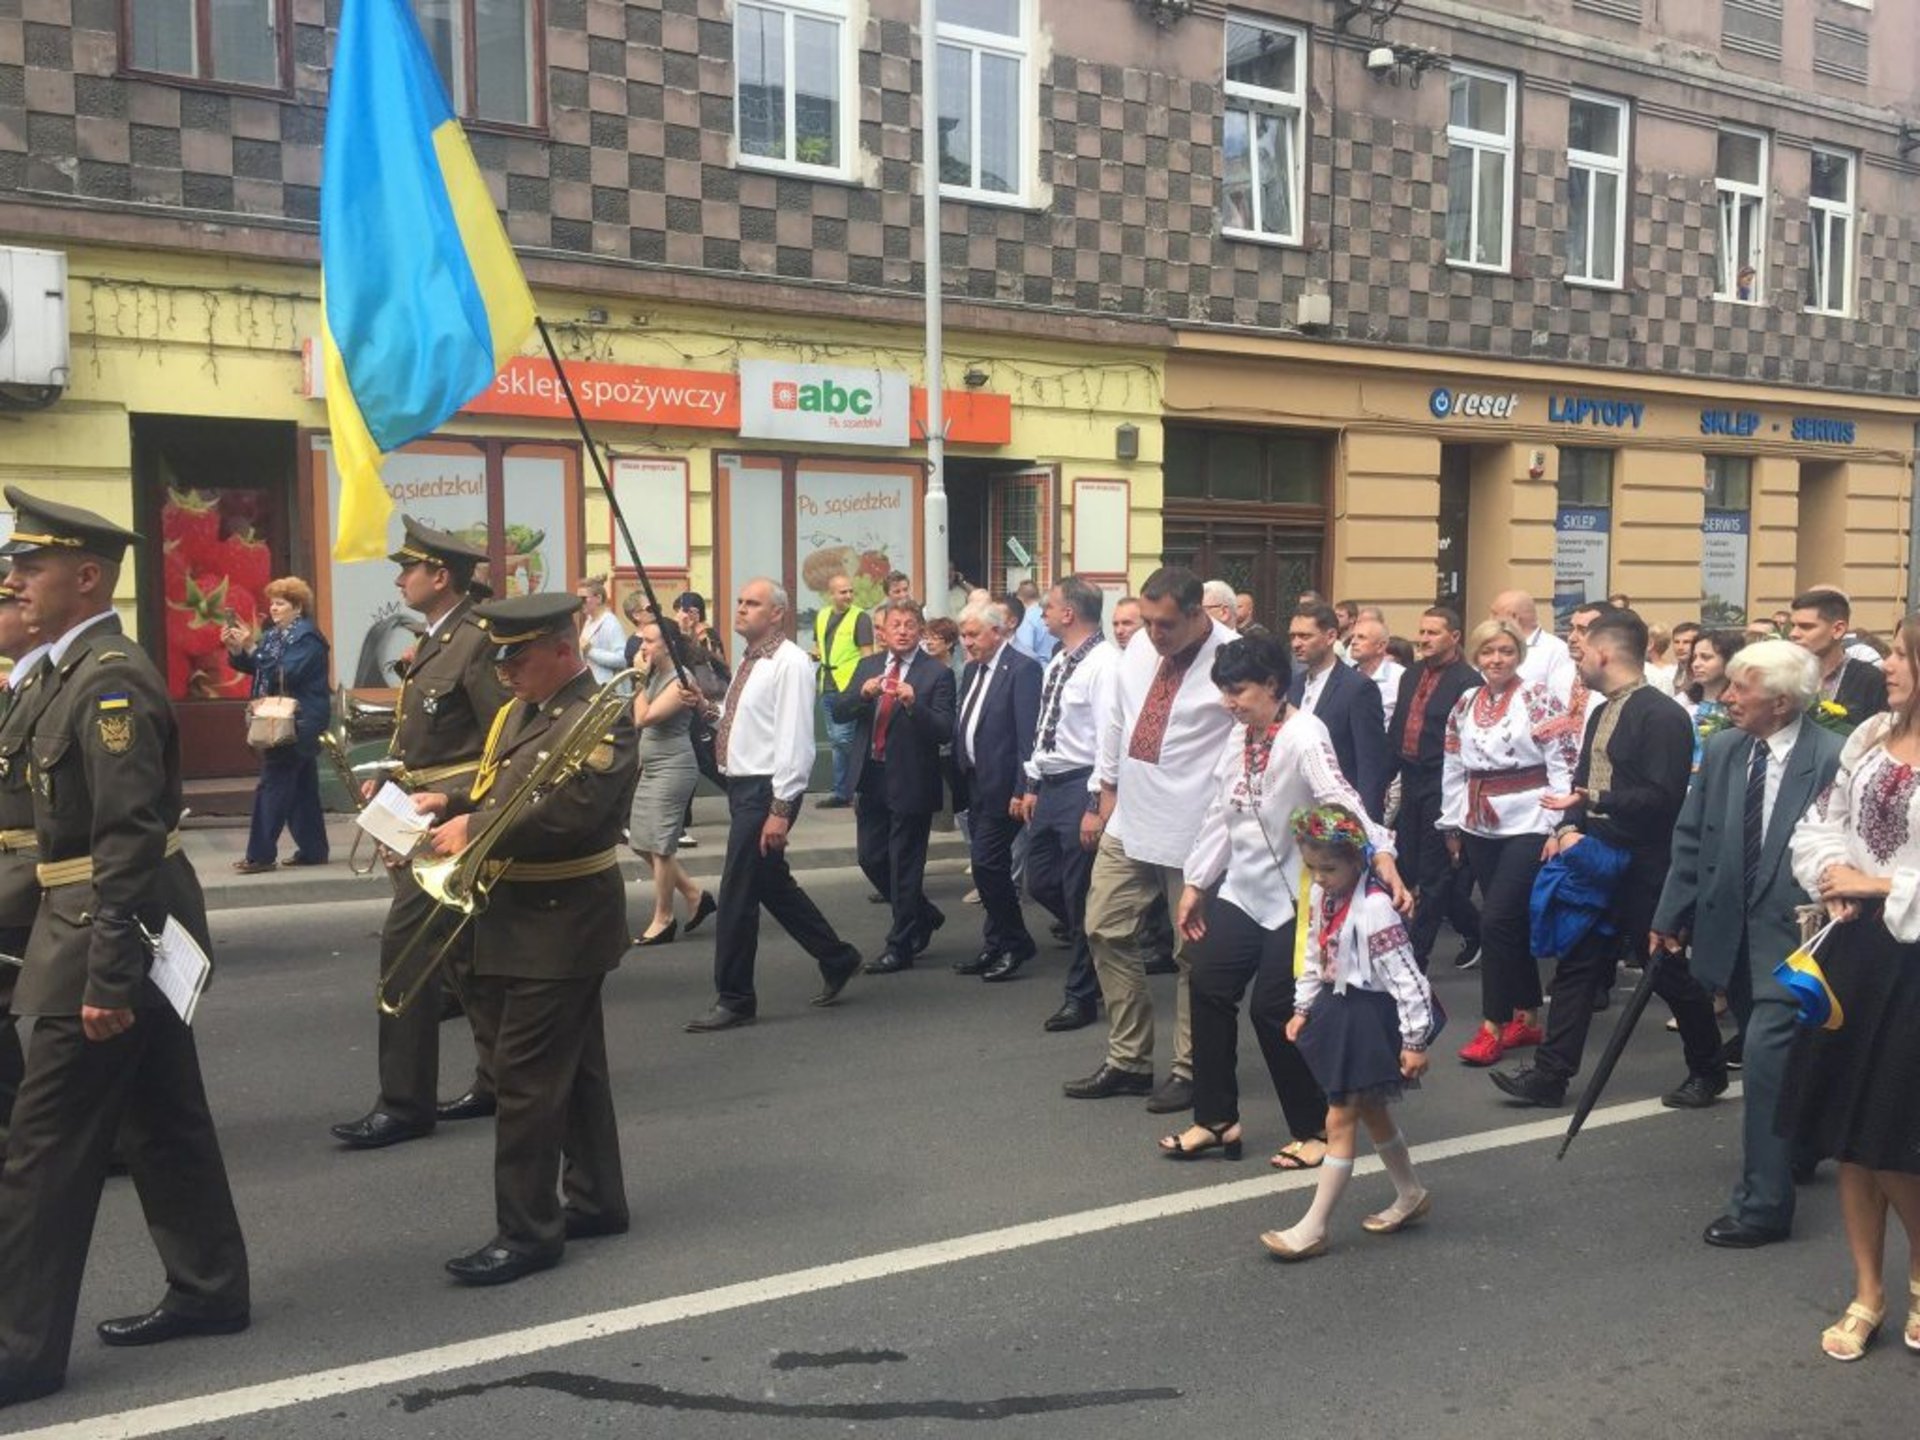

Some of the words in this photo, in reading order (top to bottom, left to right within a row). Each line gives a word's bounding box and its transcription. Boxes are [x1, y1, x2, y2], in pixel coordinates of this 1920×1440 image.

[496, 367, 573, 404] sklep
[581, 378, 726, 415] spożywczy
[799, 380, 873, 415] abc
[1452, 392, 1519, 418] reset
[1549, 395, 1645, 428] LAPTOPY
[1700, 409, 1760, 436] SKLEP
[1791, 417, 1856, 444] SERWIS
[798, 494, 818, 516] Po
[1563, 514, 1597, 530] SKLEP
[1703, 517, 1741, 532] SERWIS
